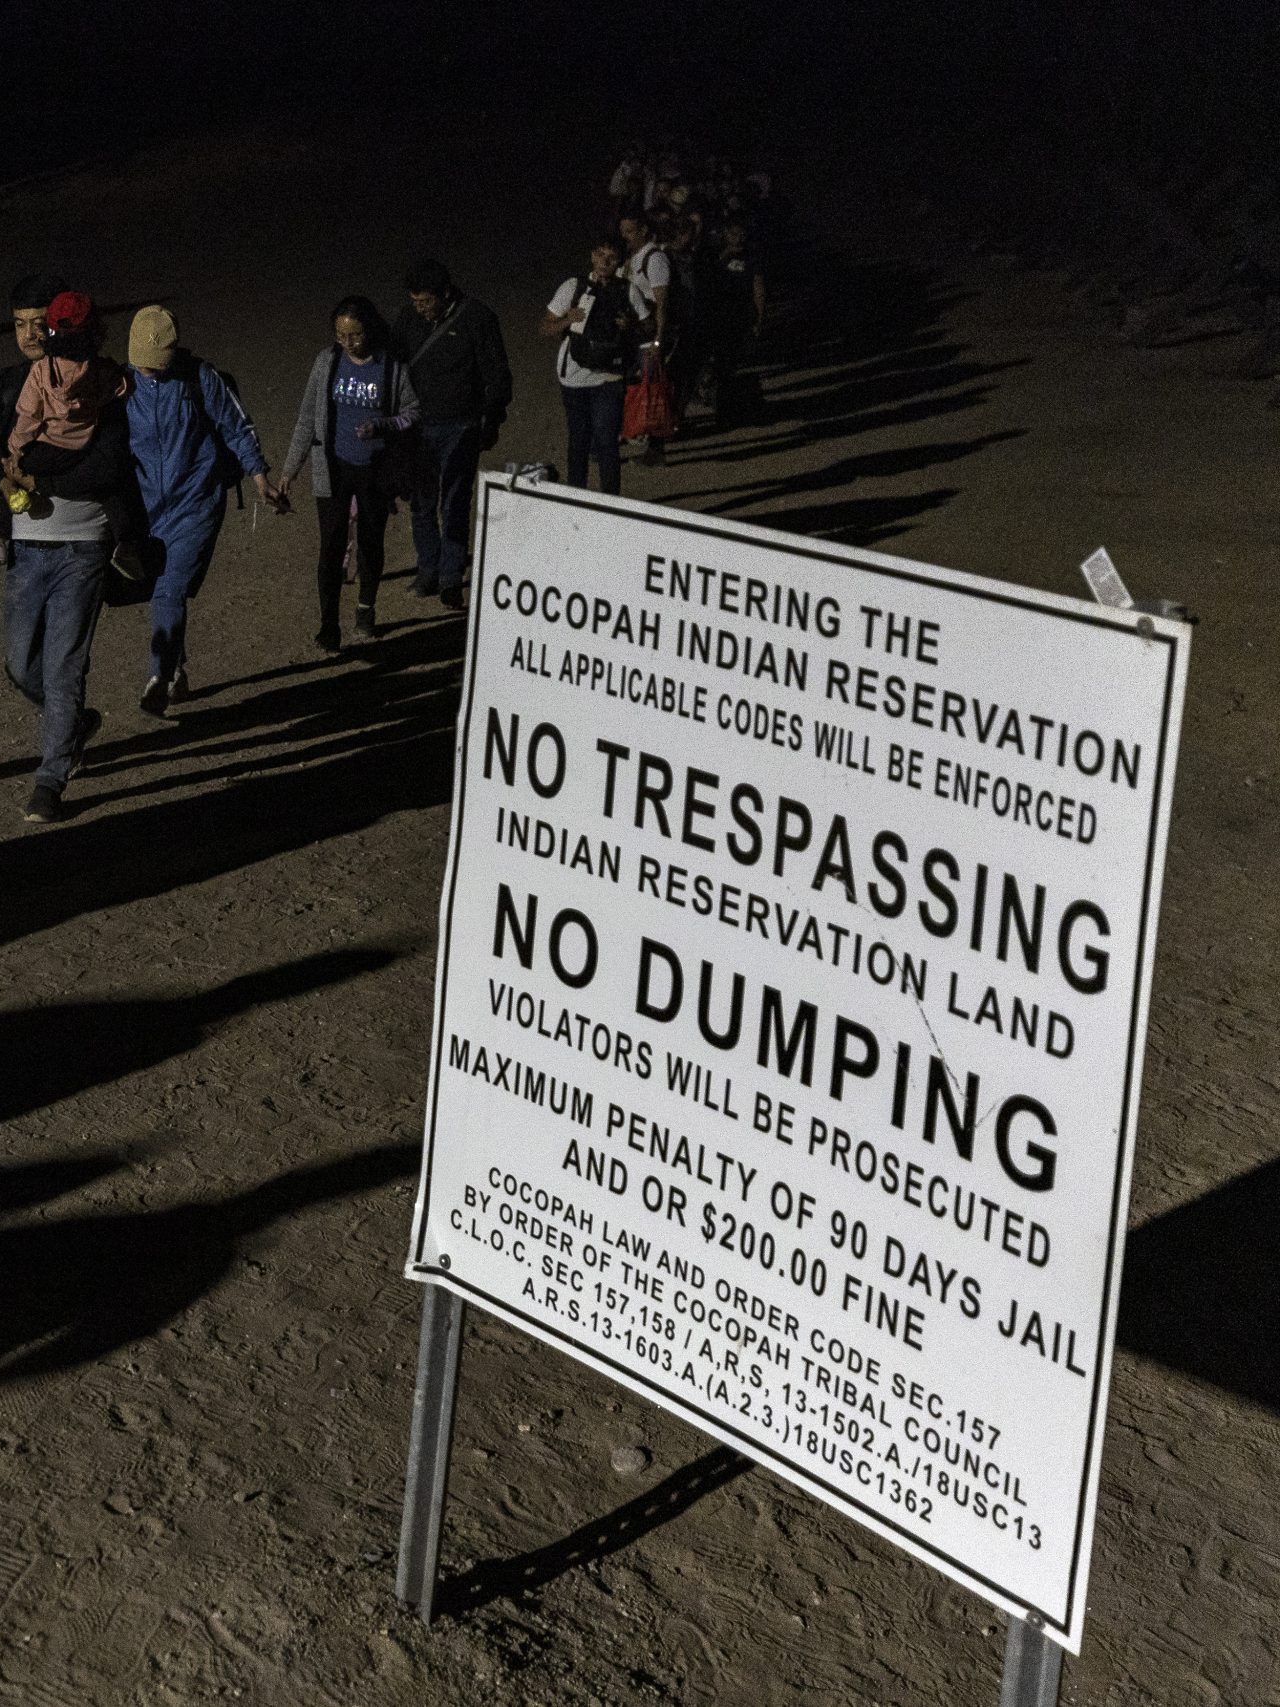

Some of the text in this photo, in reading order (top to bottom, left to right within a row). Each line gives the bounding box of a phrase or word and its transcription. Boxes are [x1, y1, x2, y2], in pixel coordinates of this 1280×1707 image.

[493, 574, 1141, 789] COCOPAH INDIAN RESERVATION
[511, 637, 1096, 844] ALL APPLICABLE CODES WILL BE ENFORCED
[645, 554, 940, 665] ENTERING THE
[484, 707, 1110, 995] NO TRESPASSING
[497, 808, 1074, 1059] INDIAN RESERVATION LAND
[490, 979, 1050, 1267] VIOLATORS WILL BE PROSECUTED
[493, 883, 1057, 1192] NO DUMPING
[450, 1034, 1085, 1377] MAXIMUM PENALTY OF 90 DAYS JAIL
[451, 1209, 531, 1266] C.L.O.C.
[542, 1255, 583, 1292] SEC
[595, 1283, 675, 1340] 157,158
[489, 1167, 1000, 1449] COCOPAH LAW AND ORDER CODE SEC.157
[562, 1139, 924, 1351] AND OR $200.00 FINE
[465, 1185, 1026, 1506] BY ORDER OF THE COCOPAH TRIBAL COUNCIL
